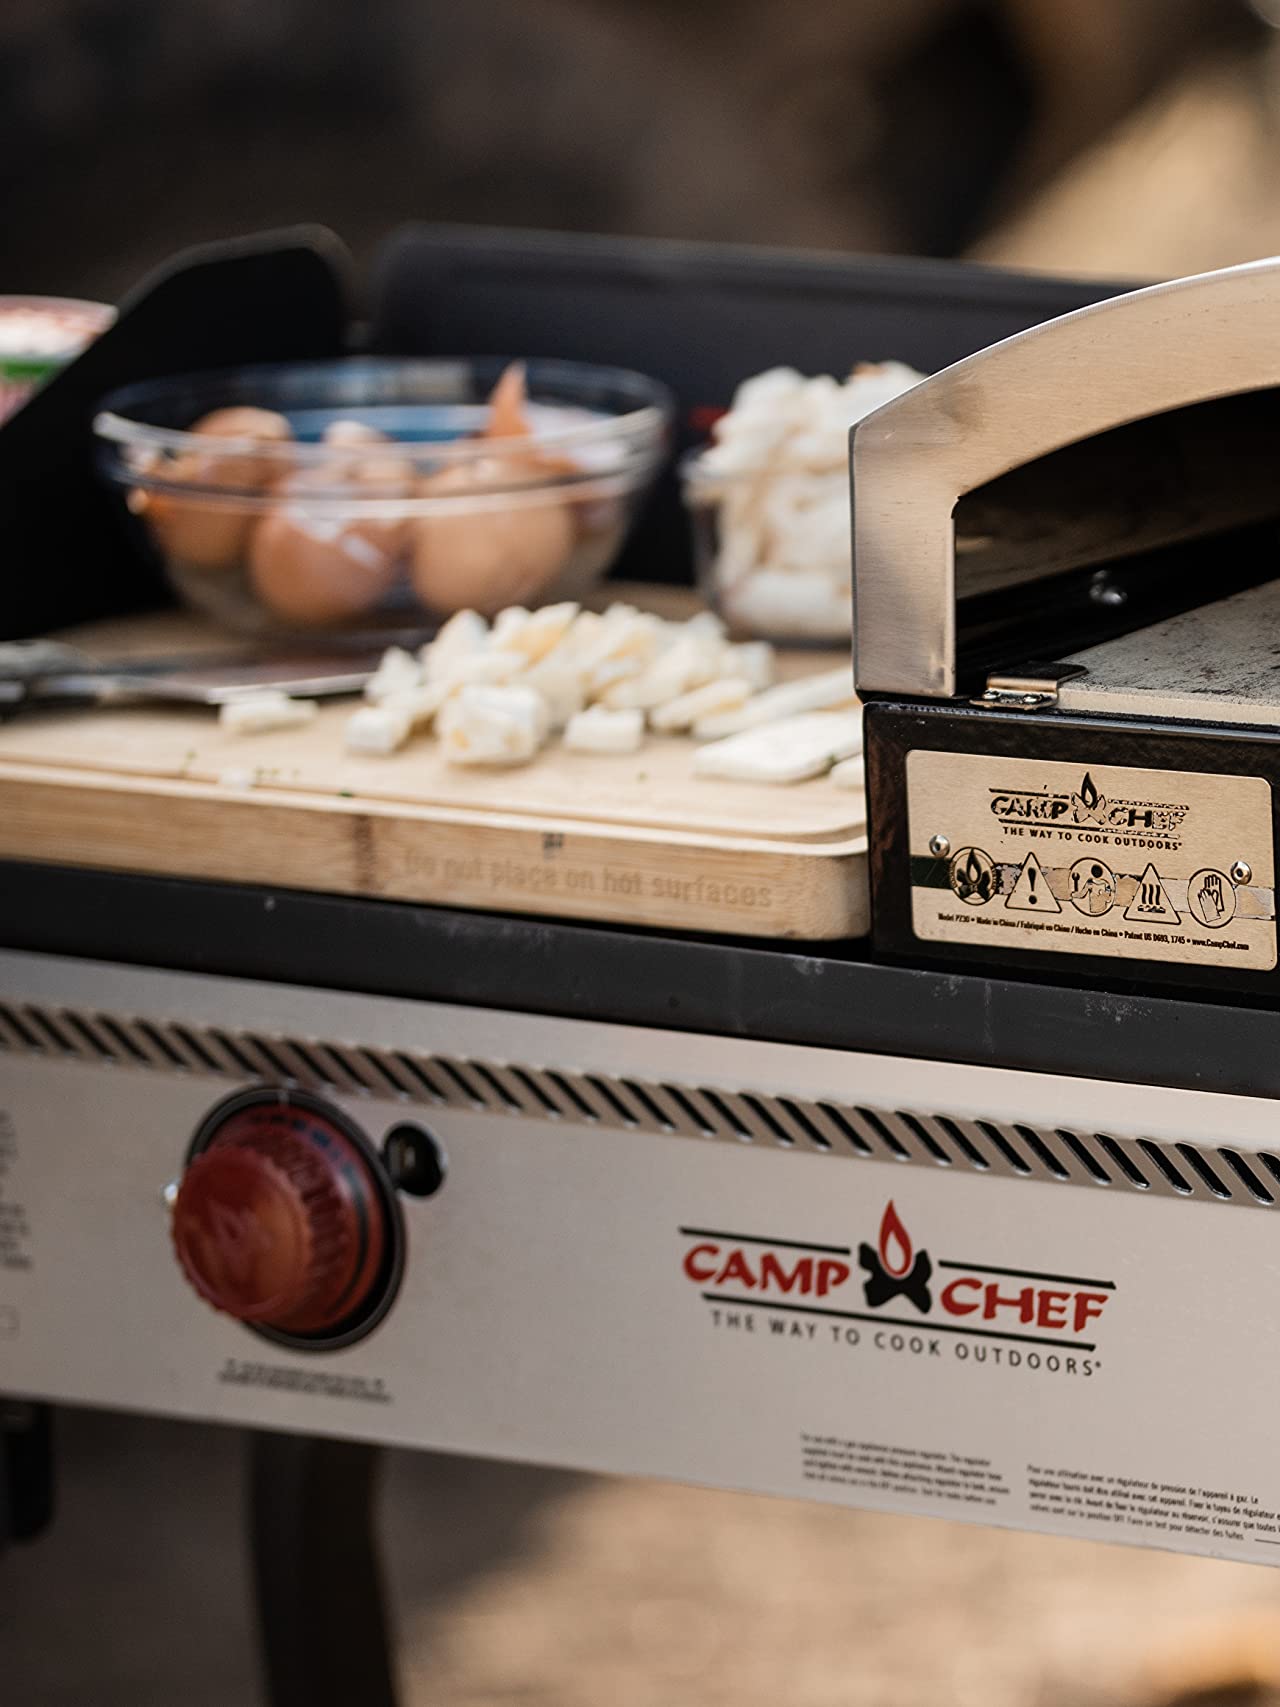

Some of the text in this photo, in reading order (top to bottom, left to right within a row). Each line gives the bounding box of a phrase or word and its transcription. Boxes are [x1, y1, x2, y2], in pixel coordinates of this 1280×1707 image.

[990, 796, 1187, 832] CAMP CHEF
[1003, 826, 1024, 836] THE
[1030, 828, 1052, 839] WAY
[1058, 831, 1072, 841] TO
[1078, 833, 1109, 845] COOK
[651, 873, 773, 909] surfaces
[682, 1243, 1109, 1333] CAMP CHEF
[710, 1309, 754, 1333] THE
[768, 1318, 817, 1340] WAY
[831, 1326, 860, 1346] TO
[874, 1332, 942, 1357] COOK
